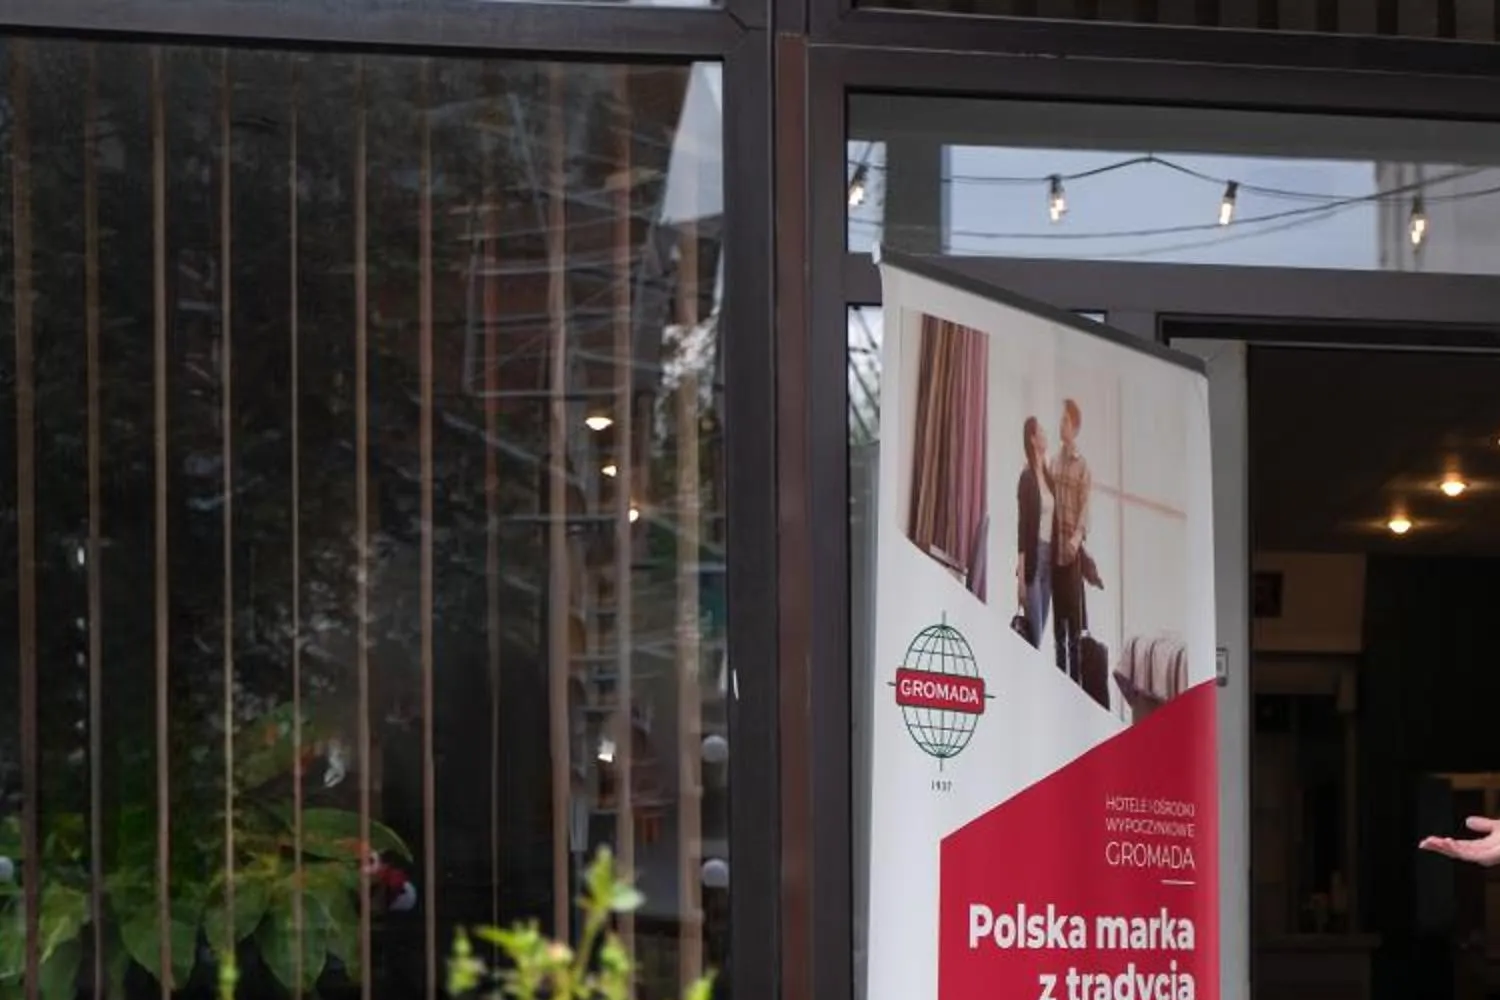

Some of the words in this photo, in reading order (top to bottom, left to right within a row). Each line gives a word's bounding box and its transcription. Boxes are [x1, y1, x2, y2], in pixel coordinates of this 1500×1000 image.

[899, 679, 979, 705] GROMADA
[1105, 795, 1146, 813] HOTELE
[1105, 817, 1195, 838] WYPOCZYNKOWE
[1105, 841, 1196, 870] GROMADA
[969, 903, 1087, 949] Polska
[1096, 907, 1195, 950] marka
